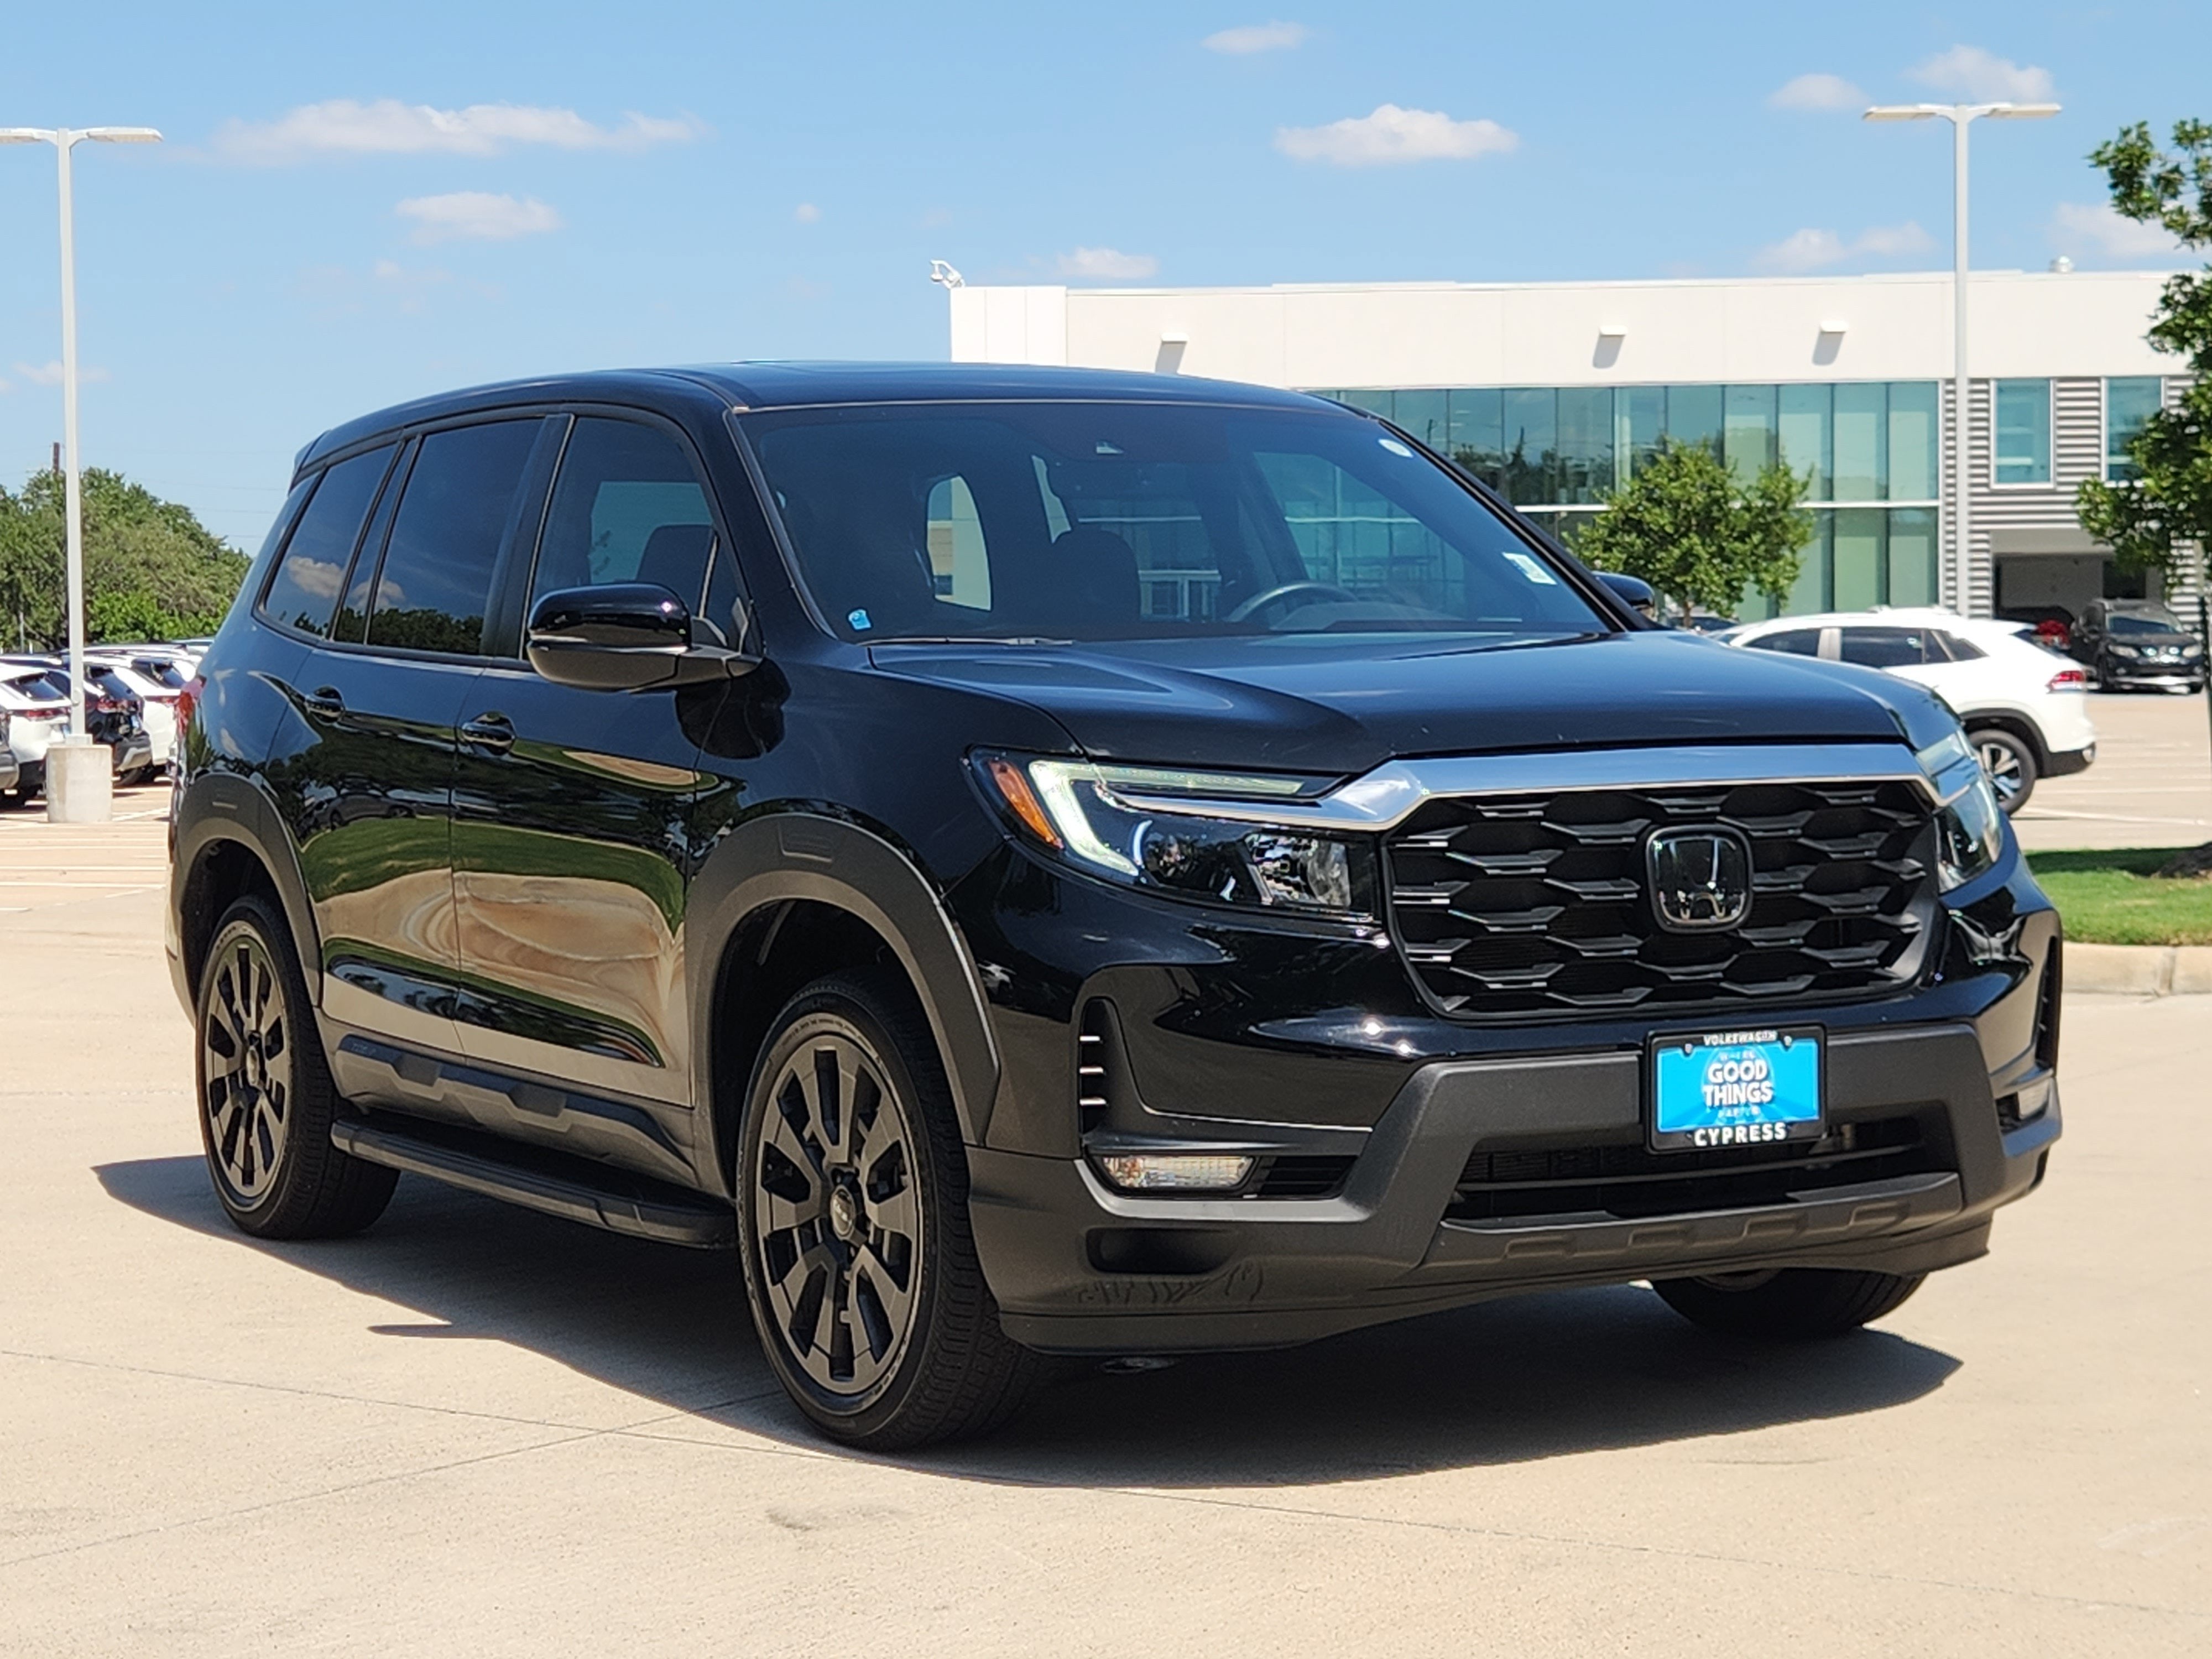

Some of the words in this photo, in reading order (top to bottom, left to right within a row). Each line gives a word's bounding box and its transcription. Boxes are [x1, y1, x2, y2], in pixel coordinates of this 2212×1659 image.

[1708, 1060, 1768, 1083] GOOD
[1703, 1081, 1773, 1106] THINGS
[1694, 1121, 1786, 1147] CYPRESS
